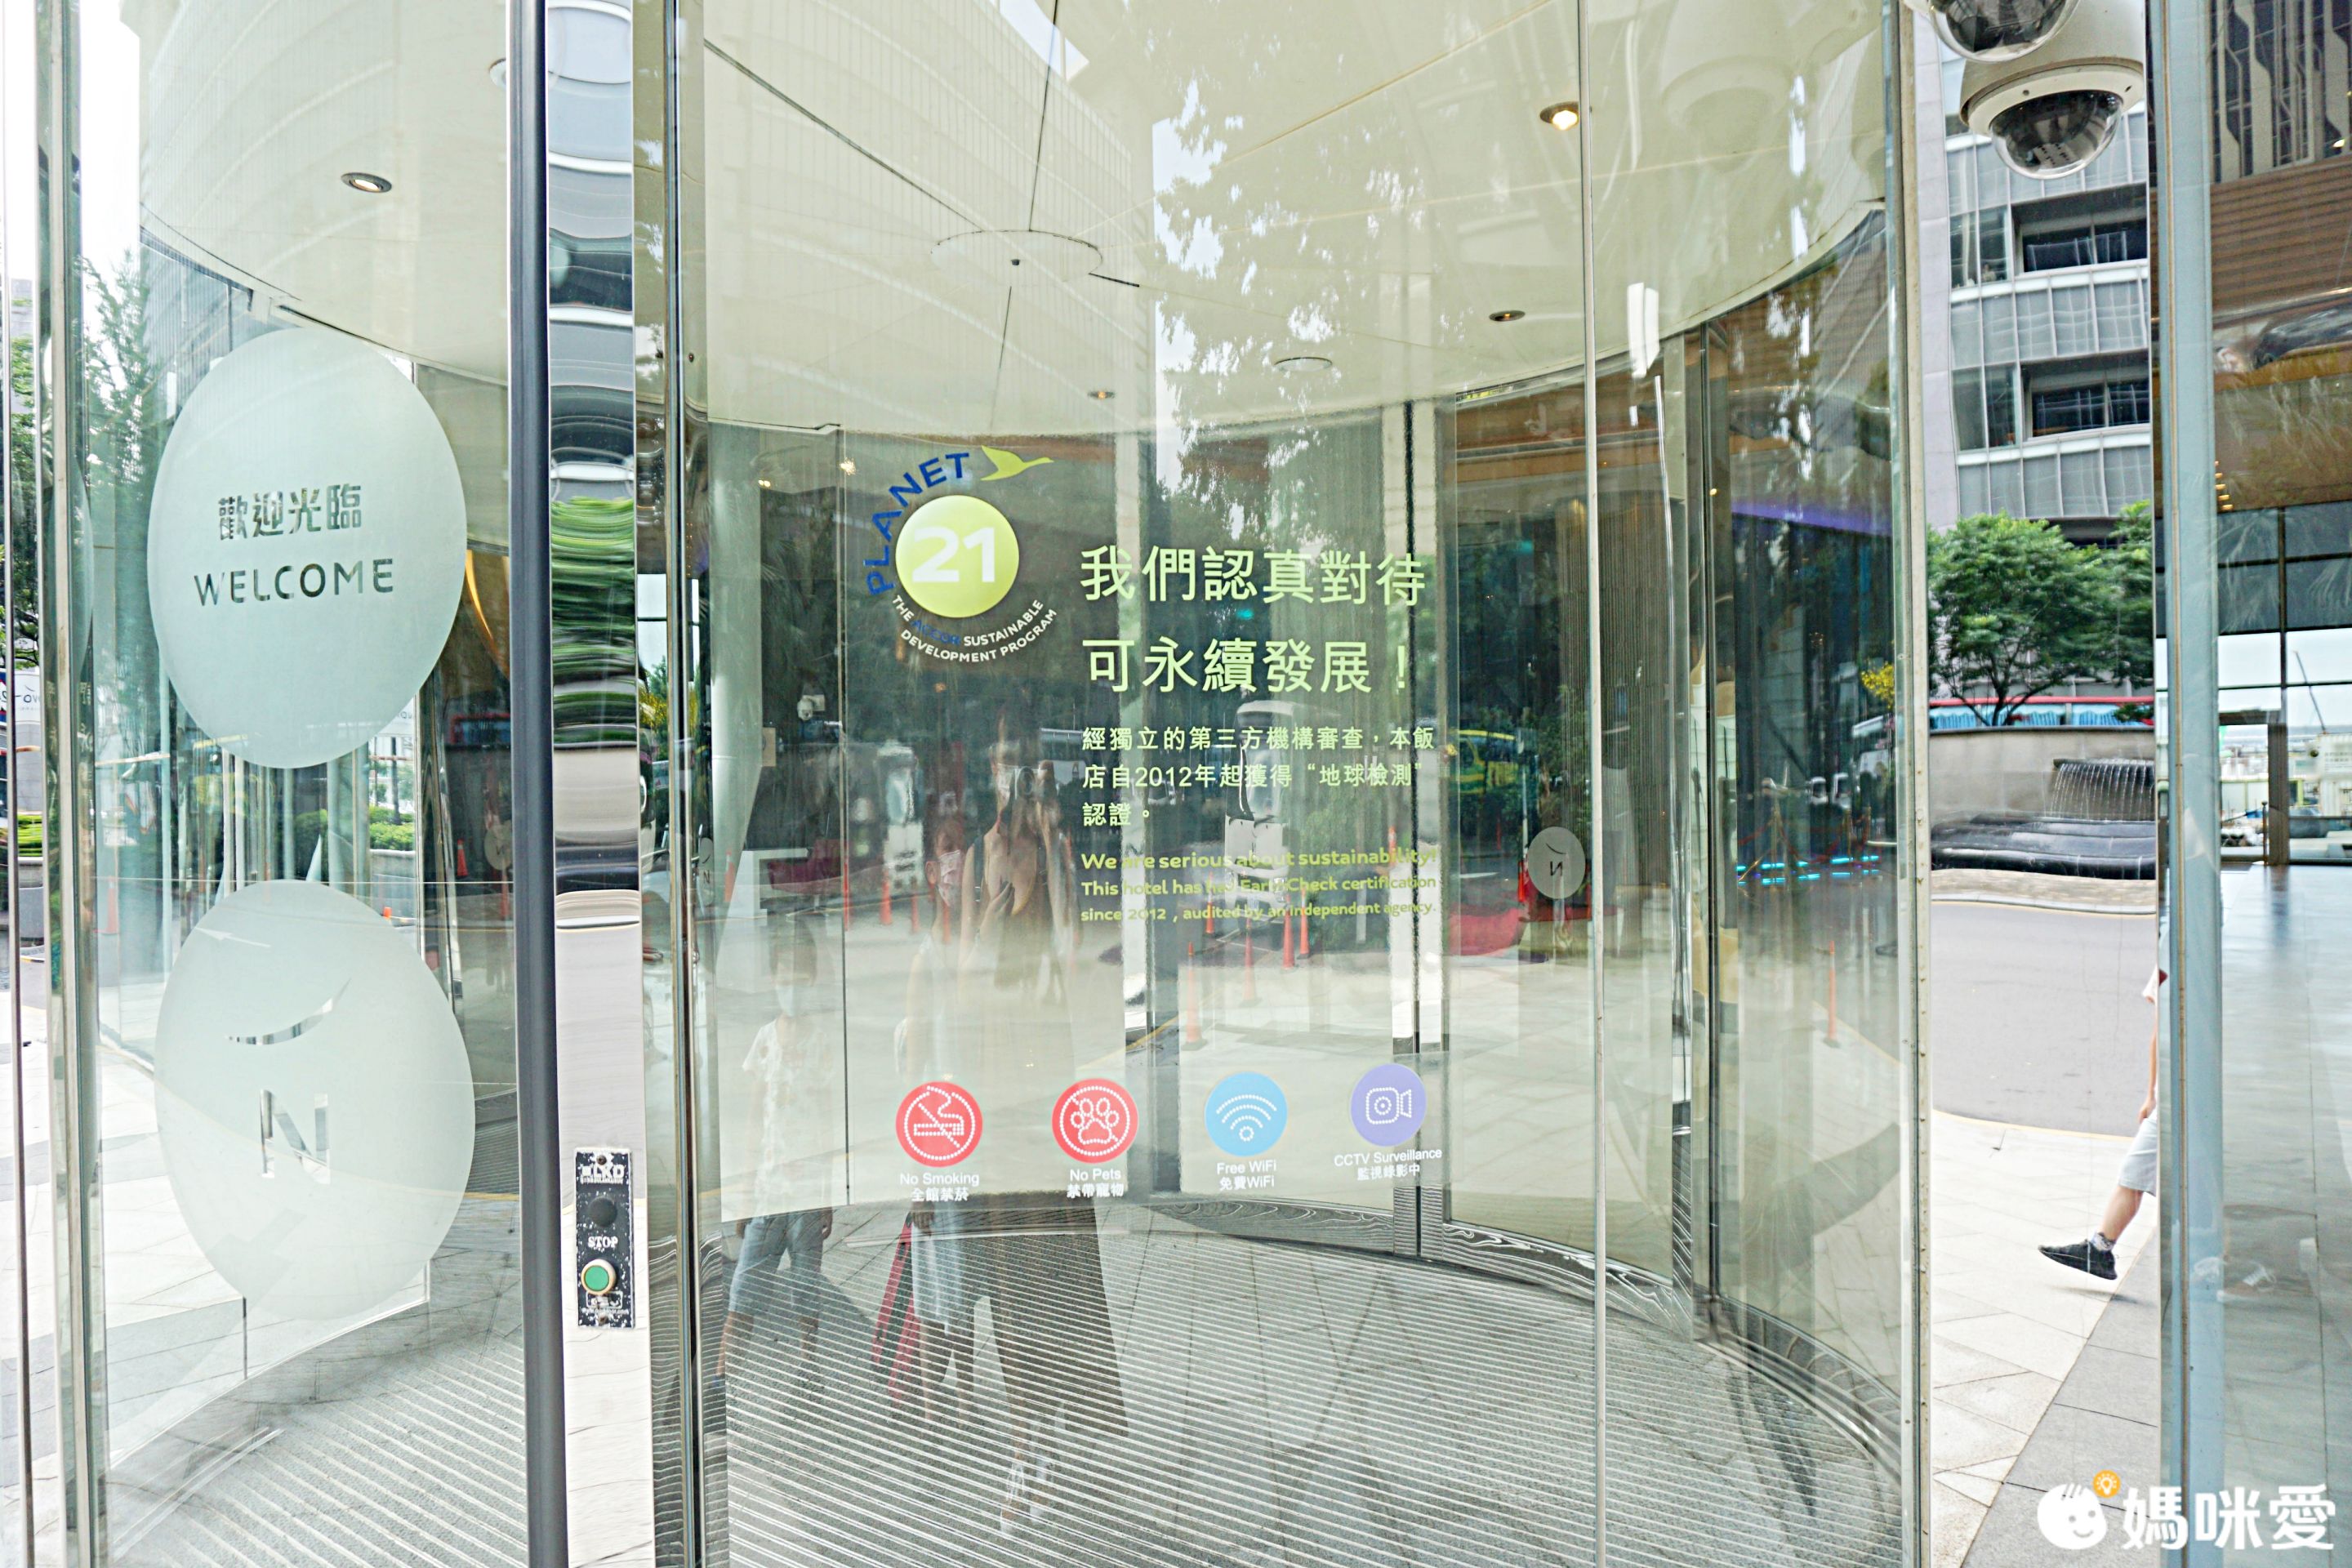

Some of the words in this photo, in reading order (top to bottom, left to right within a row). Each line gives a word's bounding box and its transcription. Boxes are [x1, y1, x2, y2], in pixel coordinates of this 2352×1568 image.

[218, 483, 362, 541] 歡迎光臨
[863, 452, 969, 595] PLANET
[911, 526, 995, 583] 21
[194, 559, 394, 606] WELCOME
[1080, 546, 1426, 608] 我們認真對待
[892, 595, 915, 621] THE
[964, 599, 1044, 647] SUSTAINABLE
[901, 629, 996, 662] DEVELOPMENT
[1000, 608, 1057, 657] PROGRAM
[1082, 803, 1149, 826] 認證。
[1081, 853, 1116, 870] We
[1122, 856, 1155, 868] are
[1159, 852, 1233, 868] serious
[1236, 849, 1294, 866] about
[1298, 847, 1437, 866] sustainability!
[1081, 881, 1119, 896] This
[1122, 879, 1168, 895] hotel
[1172, 879, 1202, 894] has
[1342, 875, 1437, 891] certification
[1081, 908, 1122, 921] since
[1183, 905, 1241, 920] audited
[1245, 904, 1263, 920] by
[1267, 906, 1286, 917] an
[1290, 902, 1380, 919] independent
[1384, 902, 1437, 917] agency.
[1217, 1162, 1245, 1174] Free
[1249, 1160, 1277, 1173] WiFi
[1334, 1153, 1370, 1167] CCTV
[1373, 1148, 1442, 1164] Surveillance
[899, 1173, 919, 1185] No
[922, 1172, 980, 1187] Smoking
[1070, 1169, 1089, 1181] No
[1093, 1168, 1122, 1180] Pets
[587, 1236, 619, 1250] STOP
